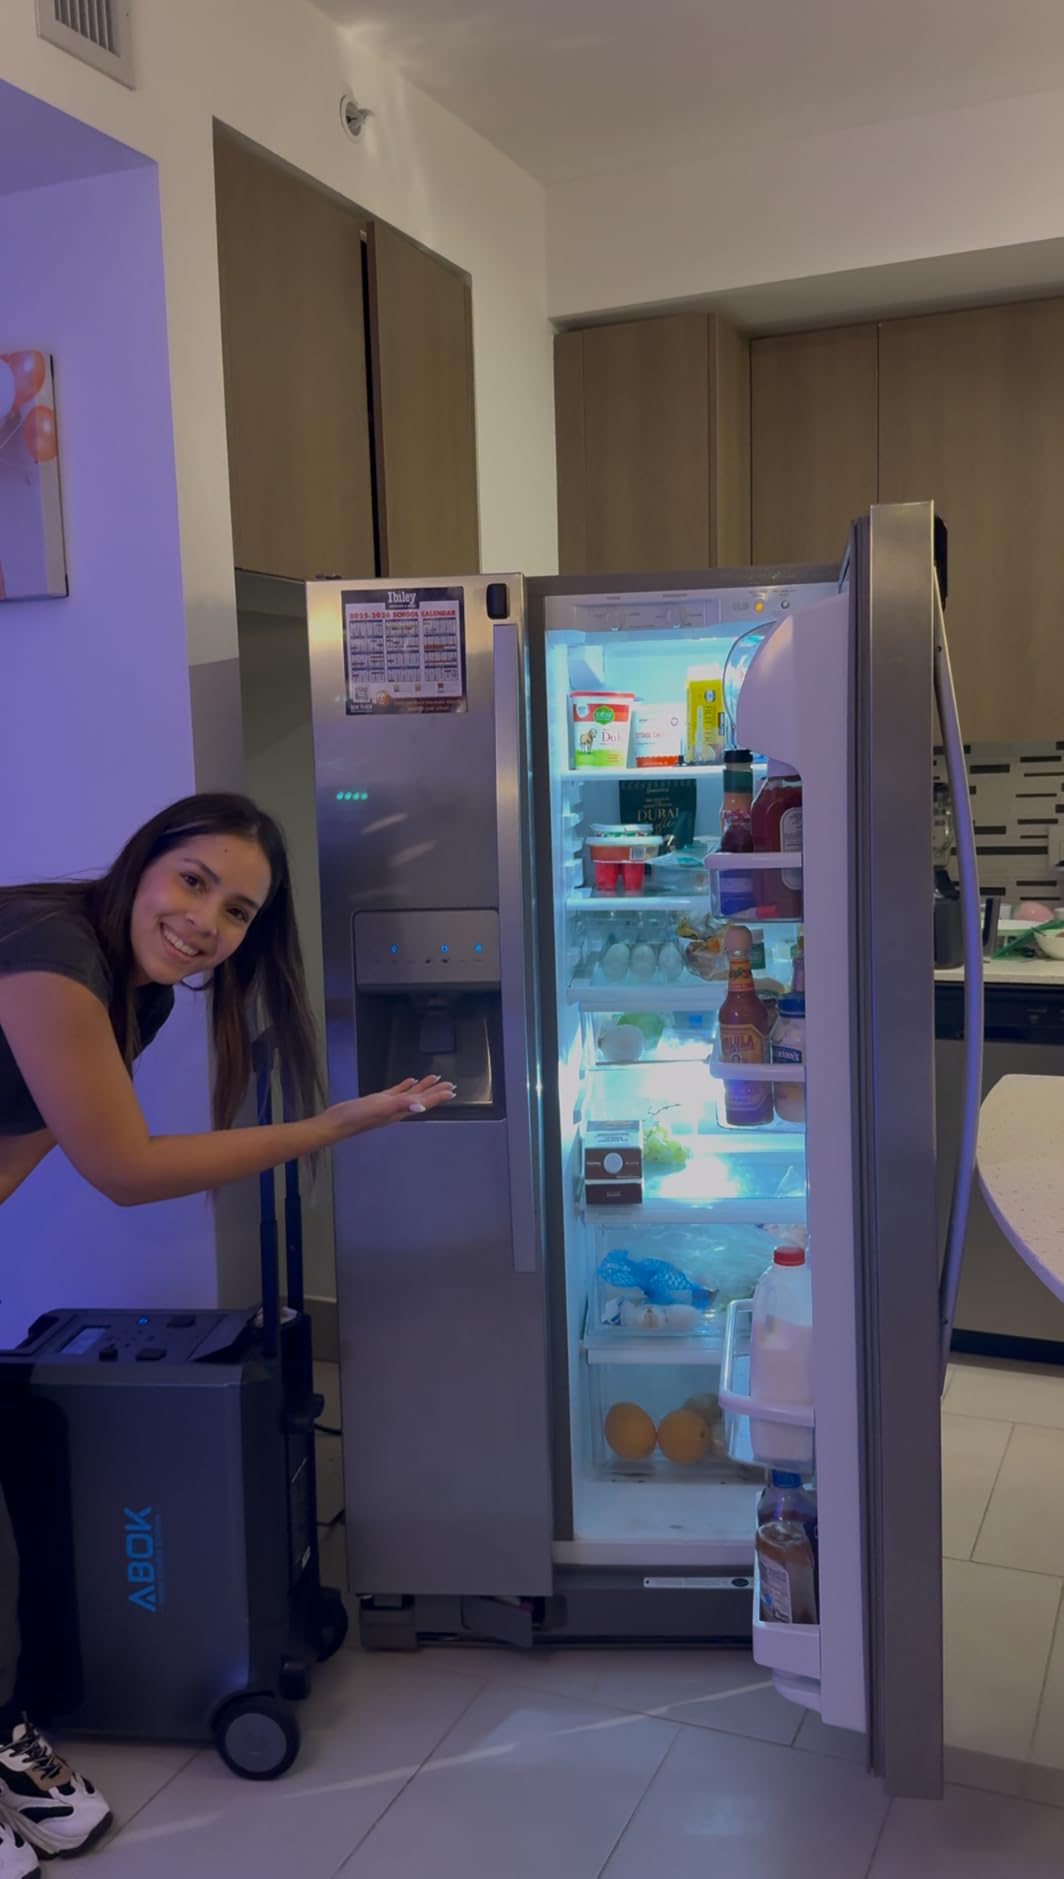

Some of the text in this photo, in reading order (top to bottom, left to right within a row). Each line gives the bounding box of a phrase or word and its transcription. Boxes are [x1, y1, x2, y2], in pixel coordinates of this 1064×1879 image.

[387, 591, 417, 605] Ibiley
[392, 610, 419, 618] SCHOOL
[123, 1505, 157, 1613] ABOK
